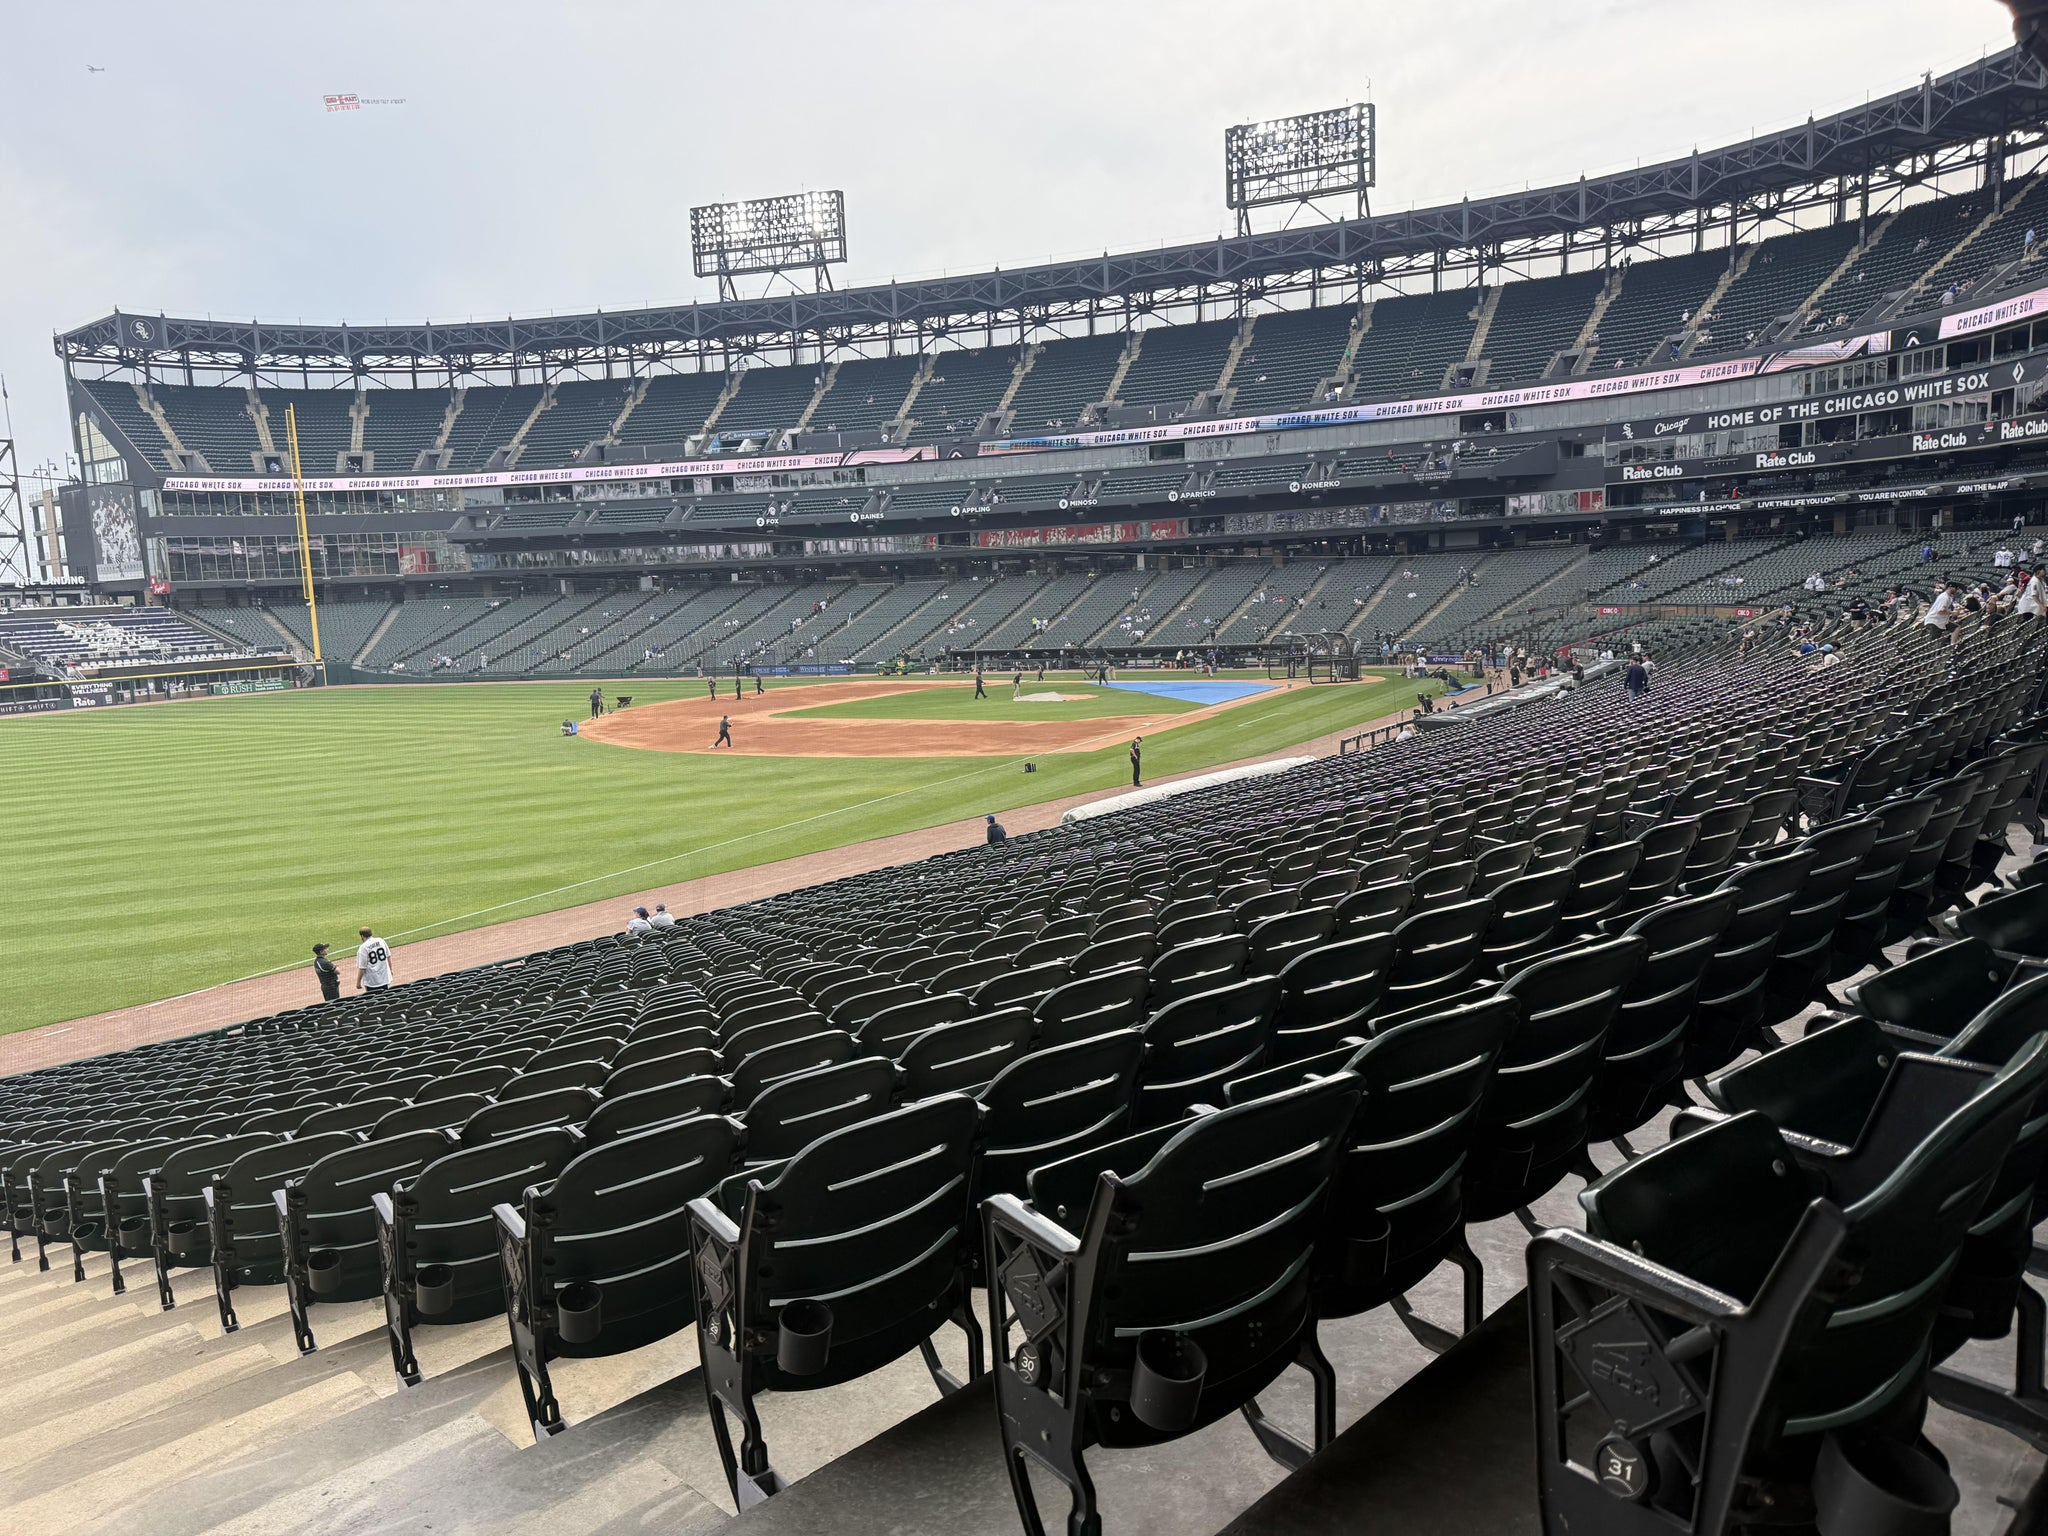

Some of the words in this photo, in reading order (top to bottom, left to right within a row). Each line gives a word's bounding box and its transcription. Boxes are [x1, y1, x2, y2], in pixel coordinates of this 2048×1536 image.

[1957, 311, 1993, 330] CHICAGO
[1995, 304, 2017, 321] WHITE
[2019, 298, 2034, 313] SOX
[1700, 364, 1738, 379] CHICAGO
[1631, 376, 1659, 388] WHITE
[1662, 373, 1681, 383] SOX
[1481, 394, 1520, 406] CHICAGO
[1523, 390, 1551, 402] WHITE
[1553, 388, 1571, 398] SOX
[1708, 411, 1754, 429] HOME
[1759, 407, 1783, 422] OF
[1788, 401, 1820, 418] THE
[1824, 389, 1899, 414] CHICAGO
[1904, 379, 1952, 401] WHITE
[1957, 372, 1989, 392] SOX
[1376, 404, 1413, 416] CHICAGO
[1416, 402, 1443, 413] WHITE
[1445, 399, 1463, 409] SOX
[1277, 415, 1311, 426] CHICAGO
[1314, 413, 1340, 423] WHITE
[1342, 410, 1359, 420] SOX
[1183, 424, 1216, 435] CHICAGO
[1218, 422, 1243, 432] WHITE
[1244, 420, 1260, 429] SOX
[1654, 417, 1690, 436] Chicago
[2001, 420, 2024, 440] Rate
[2025, 419, 2048, 436] Club
[1066, 437, 1080, 445] SOX
[1128, 431, 1151, 441] WHITE
[1153, 429, 1168, 438] SOX
[1912, 434, 1939, 452] Rate
[1940, 432, 1967, 449] Club
[737, 460, 765, 469] CHICAGO
[766, 459, 787, 468] WHITE
[788, 458, 801, 466] SOX
[815, 456, 842, 465] CHICAGO
[1756, 452, 1786, 468] Rate
[1788, 452, 1816, 466] Club
[585, 470, 612, 478] CHICAGO
[614, 469, 634, 477] WHITE
[661, 466, 688, 474] CHICAGO
[690, 464, 709, 472] WHITE
[711, 463, 724, 471] SOX
[1623, 465, 1653, 480] Rate
[1653, 465, 1683, 477] Club
[434, 478, 463, 486] CHICAGO
[510, 474, 538, 482] CHICAGO
[539, 472, 558, 480] WHITE
[561, 471, 573, 479] SOX
[165, 481, 199, 489] CHICAGO
[201, 481, 225, 489] WHITE
[258, 481, 291, 489] CHICAGO
[319, 481, 333, 489] SOX
[406, 479, 420, 487] SOX
[1302, 480, 1341, 489] KONERKO
[1957, 485, 1973, 493] JOIN
[1996, 481, 2008, 489] APP
[1180, 490, 1216, 499] APARICIO
[1858, 493, 1874, 501] YOU
[1875, 492, 1890, 500] ARE
[1890, 491, 1898, 499] IN
[1898, 488, 1928, 498] CONTROL
[1660, 506, 1701, 515] HAPPINESS
[1715, 503, 1741, 511] CHOICE
[1757, 501, 1775, 509] LIVE
[1790, 498, 1805, 506] LIFE
[961, 506, 991, 514] APPLING
[71, 682, 113, 690] EVERYTHING
[72, 687, 108, 695] WELLNESS
[230, 685, 253, 694] RUSH
[27, 702, 49, 711] SHIFT
[73, 697, 96, 708] Rate
[368, 947, 387, 965] 88
[1021, 1356, 1034, 1372] 30
[1608, 1459, 1632, 1481] 31
